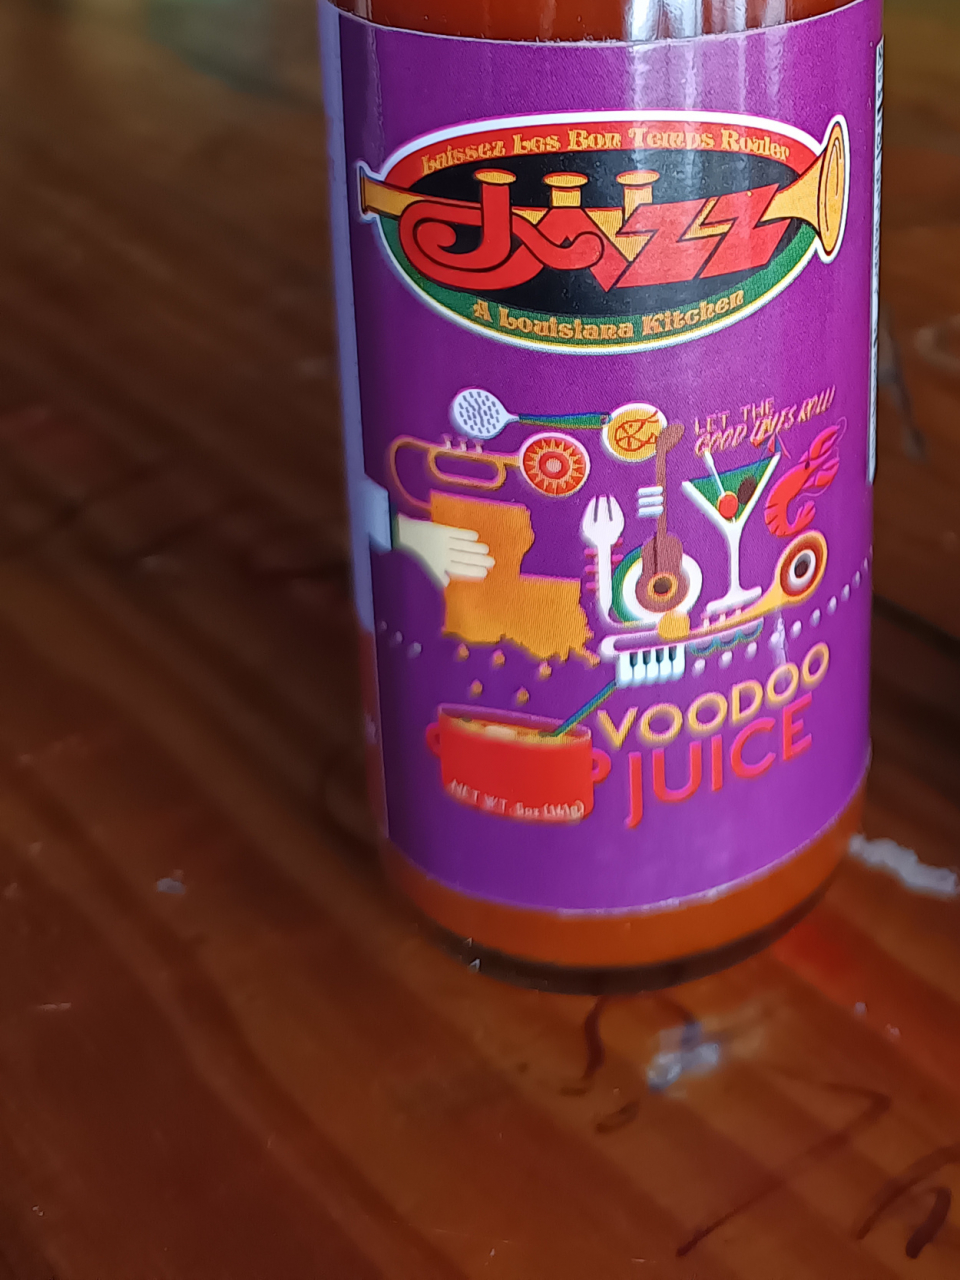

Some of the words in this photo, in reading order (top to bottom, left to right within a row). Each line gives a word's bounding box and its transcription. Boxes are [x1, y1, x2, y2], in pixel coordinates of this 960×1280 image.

[513, 133, 561, 155] Les
[567, 128, 622, 151] Bon
[628, 126, 715, 151] Temps
[472, 299, 493, 323] A
[498, 306, 635, 341] Louisiana
[640, 288, 745, 337] Kitchen
[694, 409, 731, 436] LET
[740, 396, 775, 424] THE
[694, 422, 748, 456] GOOD
[597, 641, 830, 749] VOODOO
[625, 692, 814, 830] JUICE
